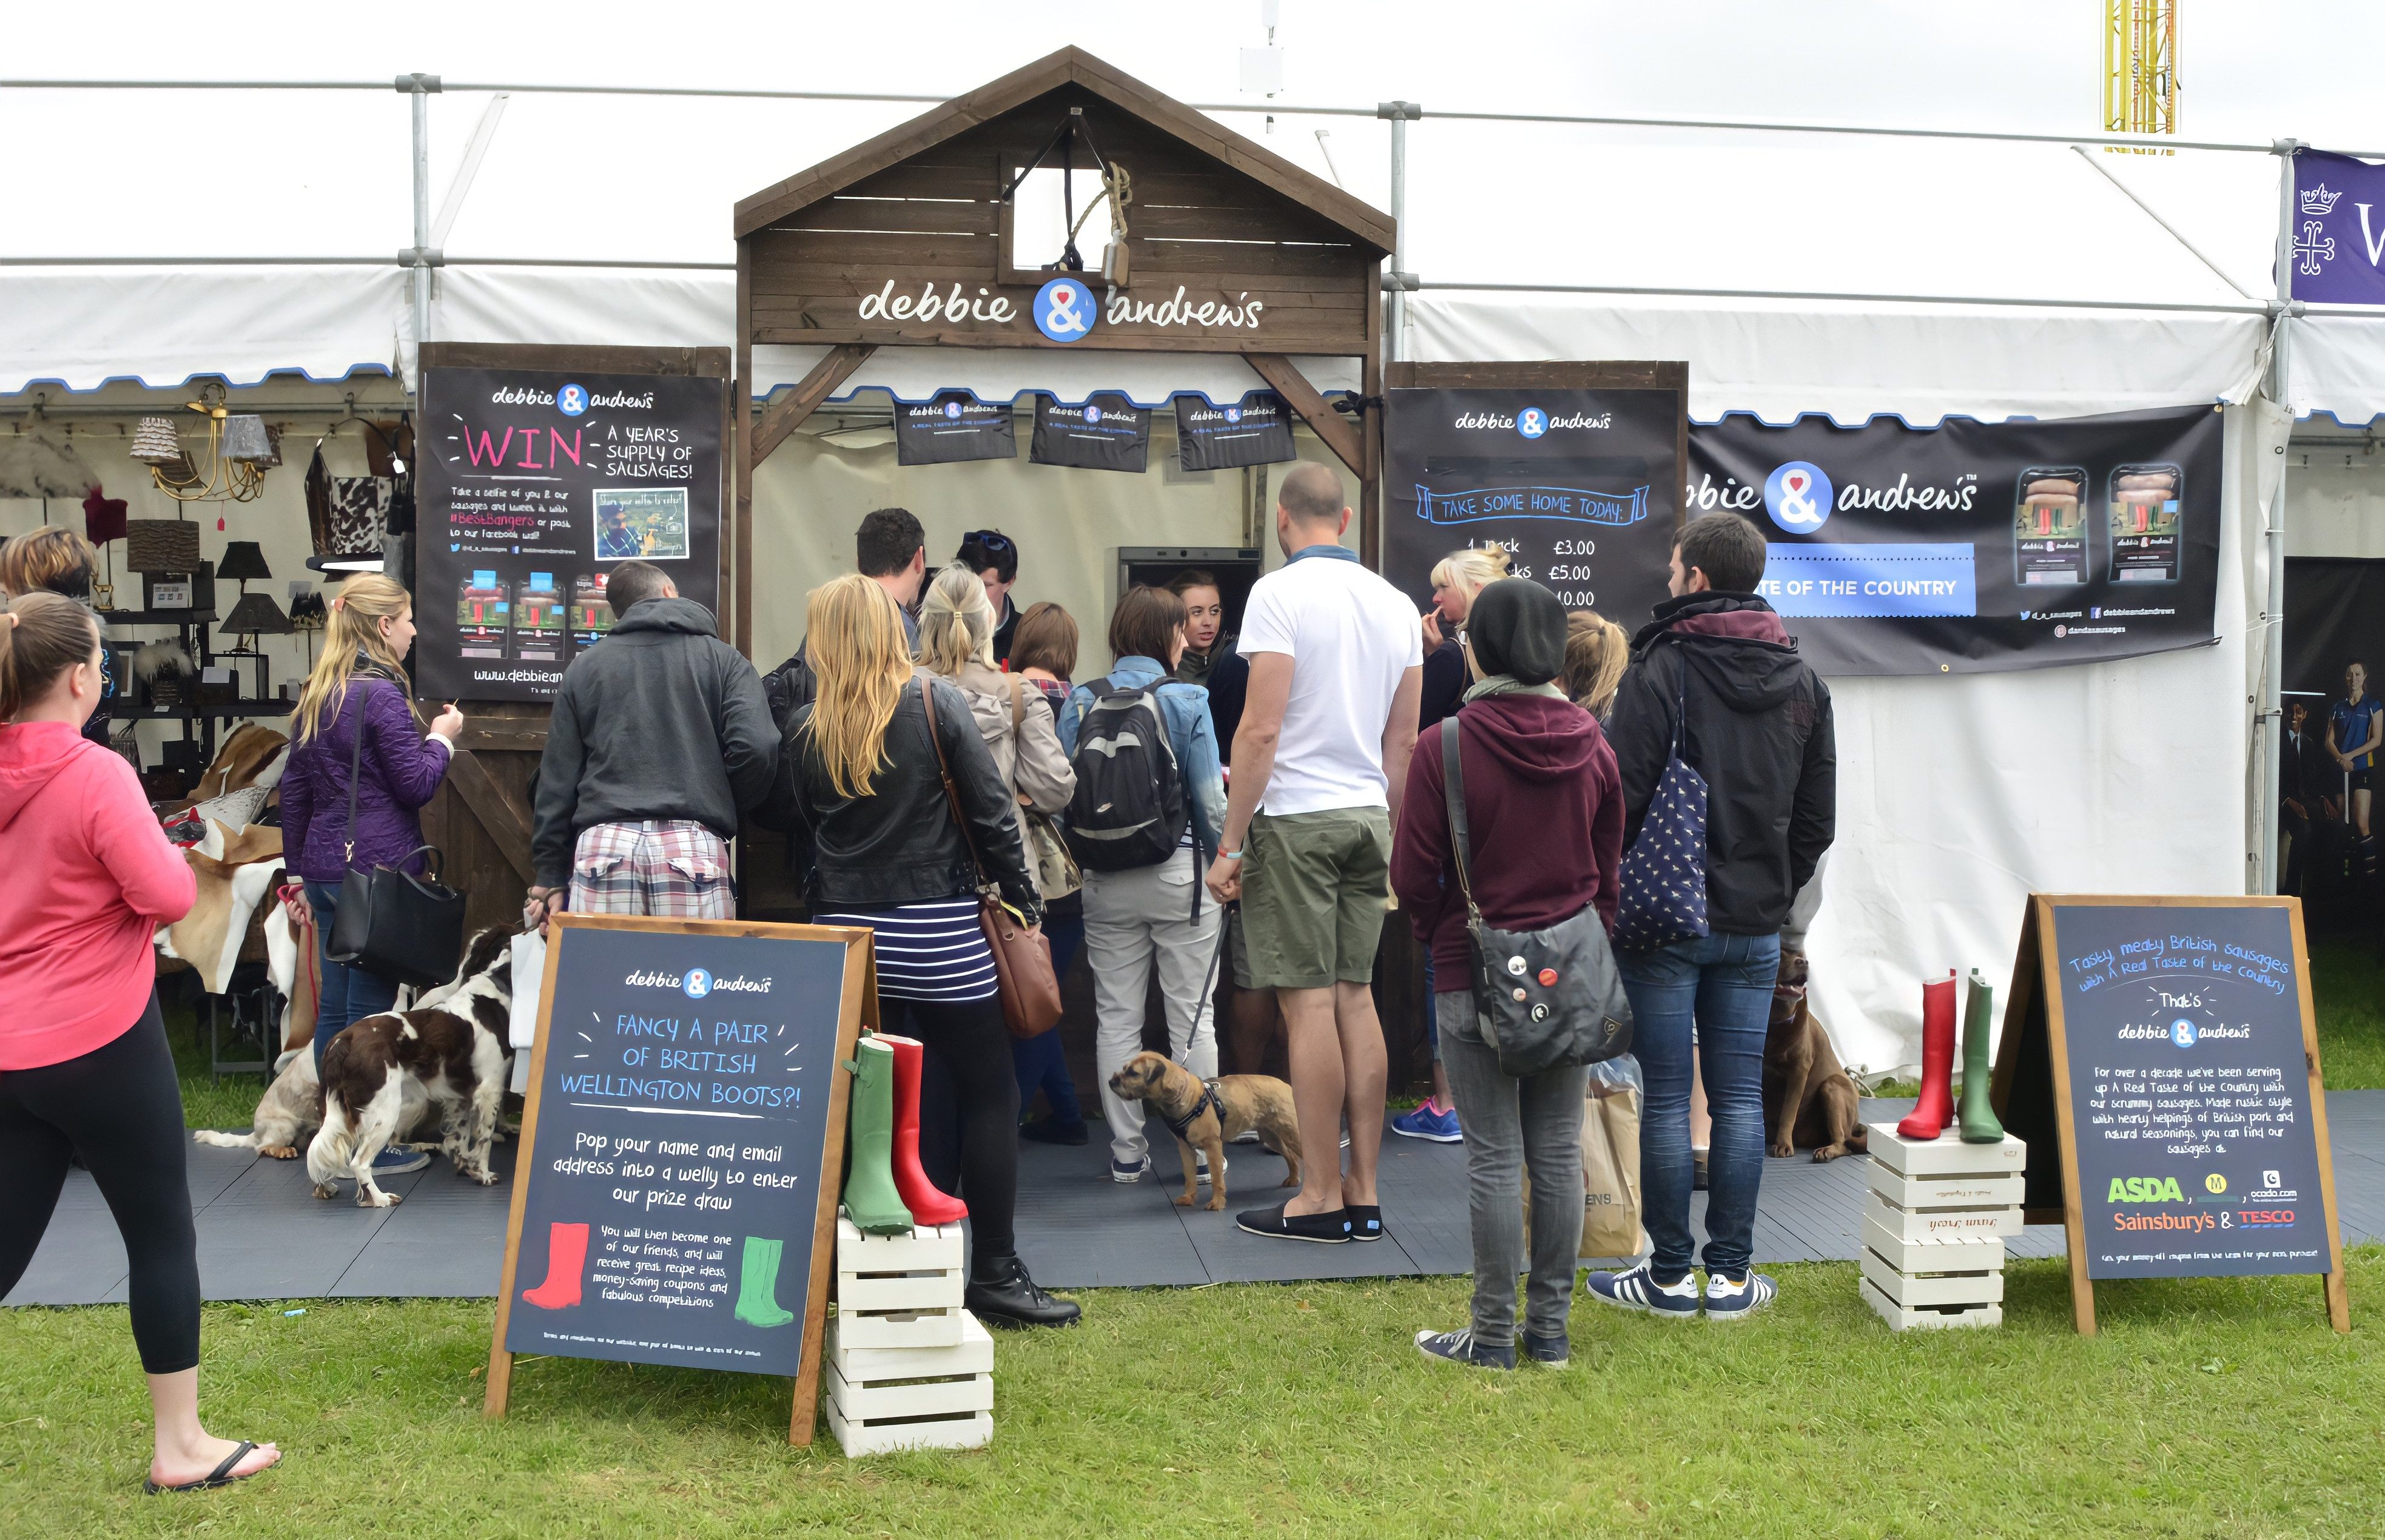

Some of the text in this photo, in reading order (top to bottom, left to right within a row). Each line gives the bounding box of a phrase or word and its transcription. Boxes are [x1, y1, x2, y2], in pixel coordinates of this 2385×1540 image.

[859, 280, 1262, 332] debbie & andrew's
[493, 386, 555, 405] debbie
[563, 387, 584, 412] &
[1455, 412, 1515, 429] debbie
[1523, 411, 1543, 434] &
[608, 425, 678, 443] A YEAR'S
[465, 426, 581, 469] WIN
[607, 445, 691, 462] SUPPLY OF
[606, 461, 691, 479] SAUSAGES!
[511, 488, 520, 497] of
[525, 491, 540, 501] you
[1779, 468, 1822, 524] &
[491, 503, 505, 511] and
[1442, 494, 1623, 522] TAKE SOME HOME TODAY:
[451, 513, 534, 532] #BestBangers
[551, 520, 571, 531] post
[1553, 540, 1595, 555] £3.00
[1549, 565, 1590, 580] £5.00
[1757, 580, 1956, 596] TE OF THE COUNTRY
[1556, 591, 1594, 605] 10.00
[474, 670, 563, 683] www.debbiean
[2121, 939, 2164, 955] meaty
[2170, 935, 2216, 952] British
[2221, 944, 2288, 977] sausages
[626, 970, 681, 987] debbie
[688, 972, 707, 995] &
[2079, 974, 2104, 991] with
[2110, 966, 2118, 980] A
[2152, 957, 2186, 968] Taste
[2193, 956, 2205, 968] of
[2213, 960, 2232, 973] the
[2238, 963, 2284, 994] Country
[2159, 993, 2201, 1008] That's
[617, 1014, 767, 1045] FANCY A PAIR
[2118, 1024, 2169, 1039] debbie
[2175, 1021, 2194, 1044] &
[624, 1047, 756, 1073] OF BRITISH
[2095, 1068, 2110, 1077] For
[2151, 1068, 2182, 1078] decade
[2187, 1067, 2213, 1077] we've
[2218, 1068, 2241, 1077] been
[2247, 1067, 2281, 1081] serving
[562, 1074, 800, 1108] WELLINGTON BOOTS?!
[2095, 1084, 2107, 1098] up
[2113, 1082, 2119, 1092] A
[2150, 1083, 2178, 1092] Taste
[2184, 1081, 2193, 1092] of
[2199, 1083, 2215, 1092] the
[2221, 1083, 2259, 1095] Country
[2264, 1081, 2284, 1091] with
[2206, 1098, 2231, 1108] Made
[2236, 1097, 2262, 1107] rustic
[2269, 1097, 2292, 1111] style
[2093, 1114, 2113, 1123] with
[2153, 1113, 2192, 1128] helpings
[2198, 1111, 2207, 1122] of
[2213, 1112, 2245, 1122] British
[2250, 1112, 2271, 1126] pork
[2276, 1111, 2293, 1123] and
[2202, 1129, 2219, 1142] you
[2244, 1126, 2264, 1138] find
[576, 1132, 781, 1162] Pop your name and email
[2168, 1145, 2210, 1158] sausages
[554, 1157, 797, 1189] address into a welly to enter
[613, 1186, 732, 1211] our prize draw
[2114, 1211, 2295, 1232] Sainsbury's & TESCO
[602, 1225, 732, 1245] You will then become one
[607, 1241, 722, 1260] of our friends, and will
[597, 1259, 630, 1268] receive
[634, 1262, 661, 1274] great
[666, 1264, 695, 1278] recipe
[593, 1274, 727, 1294] money-saving coupons and
[602, 1288, 713, 1309] fabulous competitions
